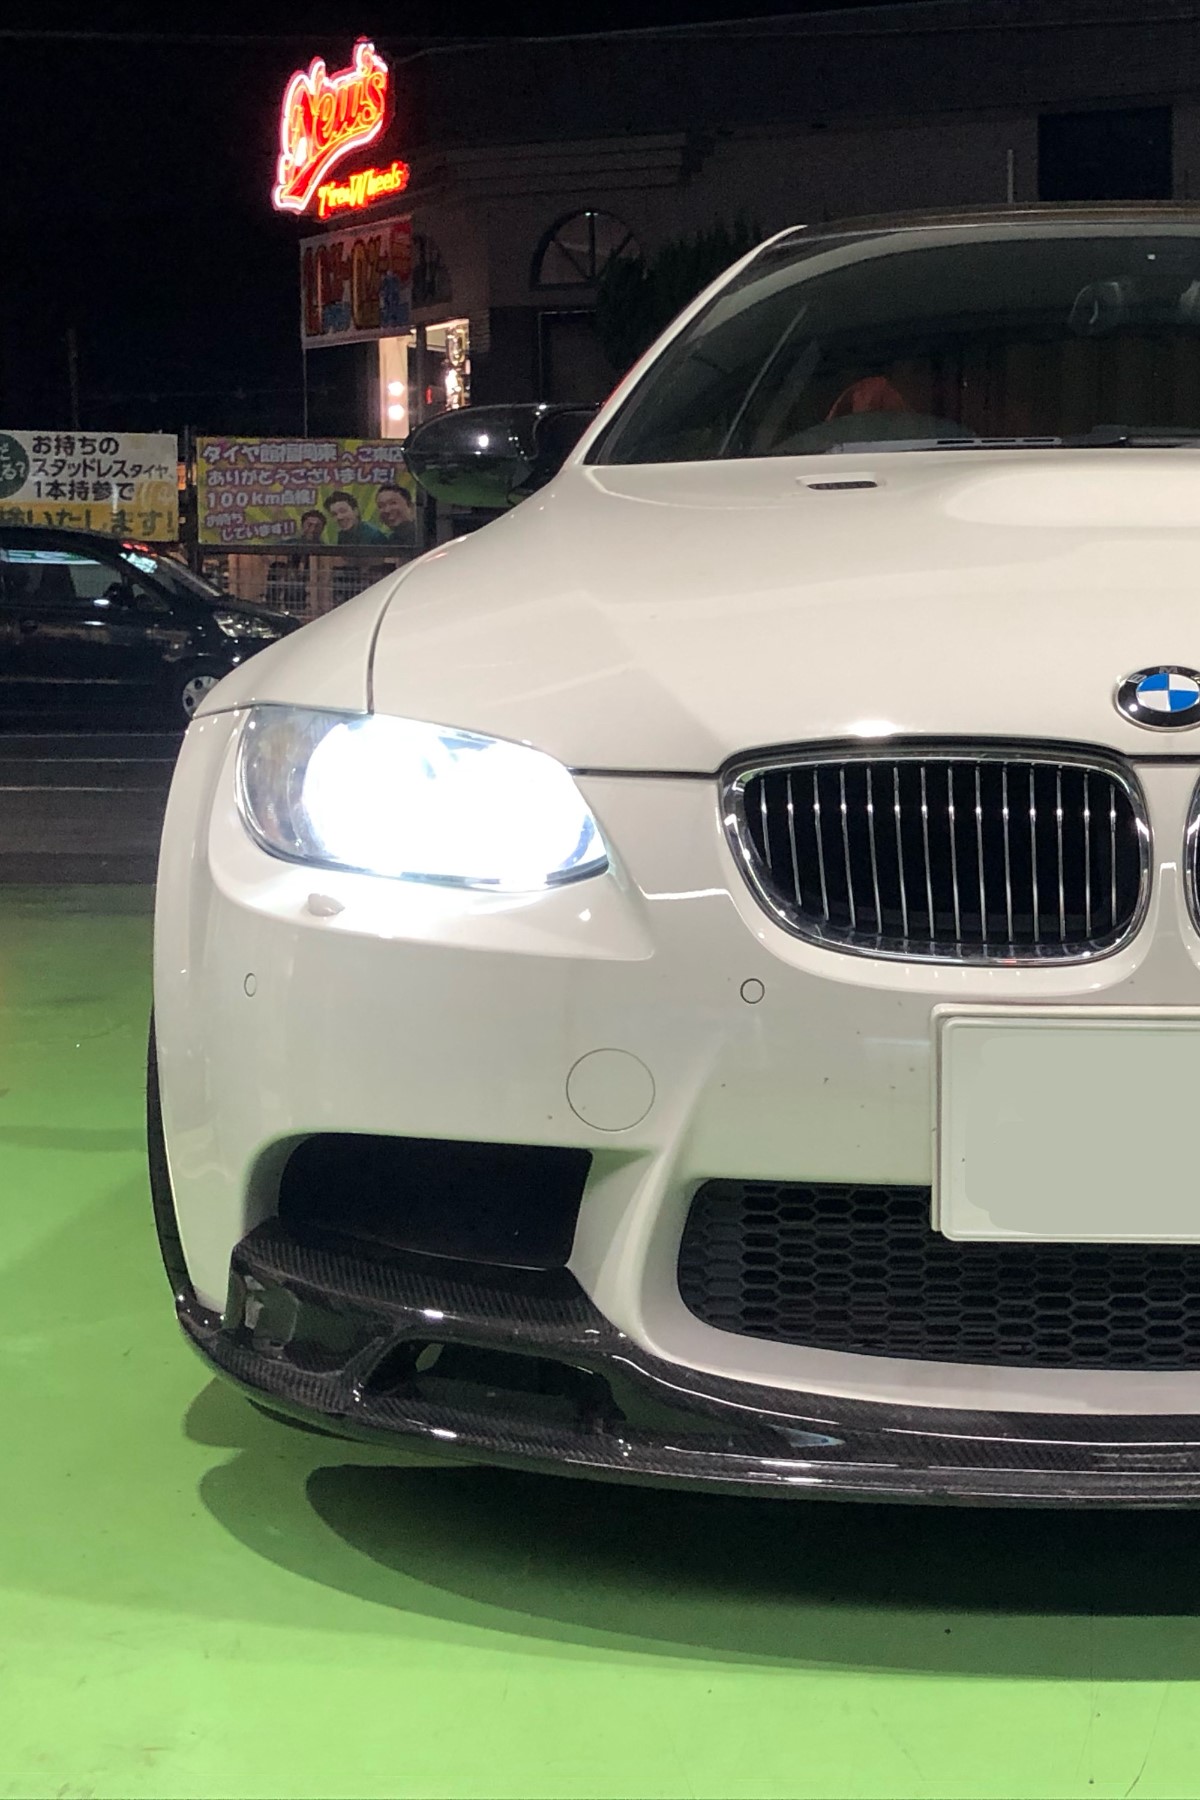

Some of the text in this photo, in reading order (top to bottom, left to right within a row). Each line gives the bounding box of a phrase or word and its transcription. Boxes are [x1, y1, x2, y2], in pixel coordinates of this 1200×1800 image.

[32, 435, 120, 456] お持ちの
[34, 480, 136, 502] 1本持参で
